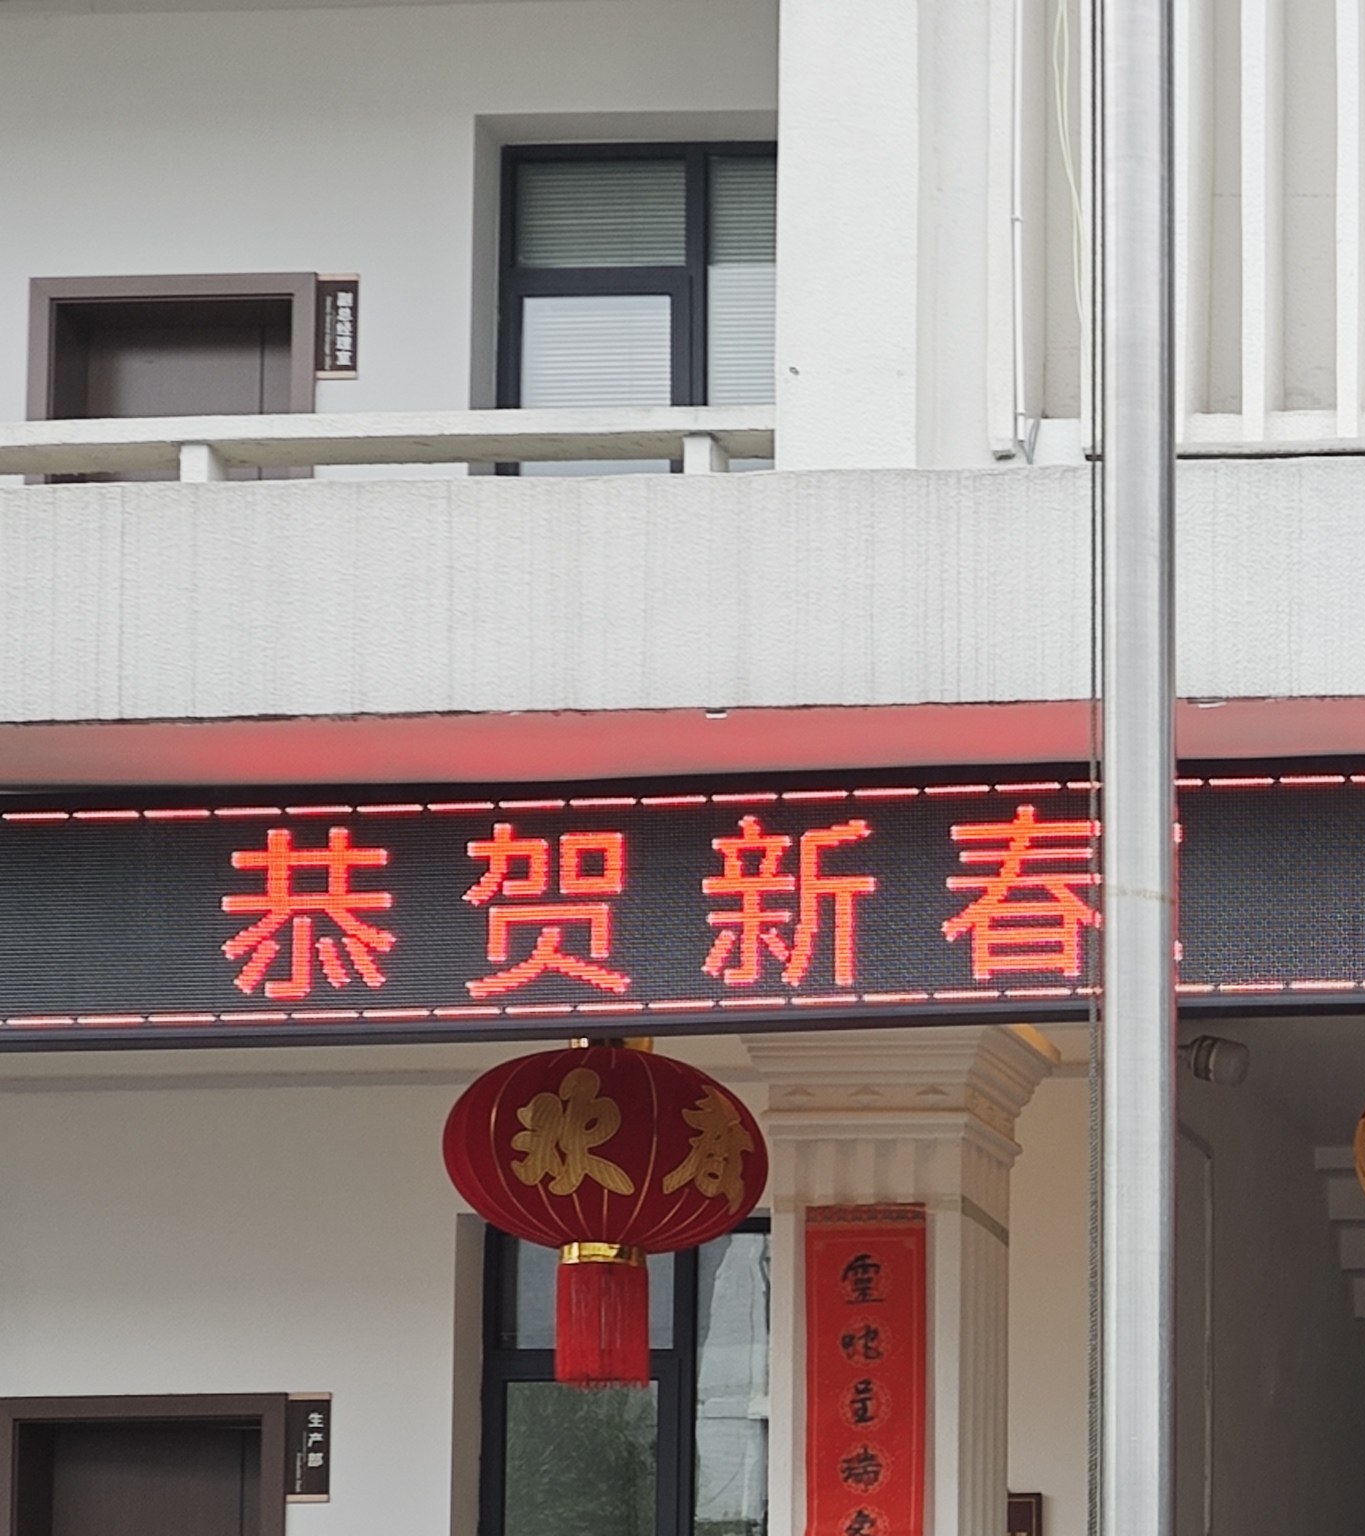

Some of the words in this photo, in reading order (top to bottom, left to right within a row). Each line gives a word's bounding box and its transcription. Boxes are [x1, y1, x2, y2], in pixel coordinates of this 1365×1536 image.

[222, 803, 1184, 999] 恭贺新春
[308, 1411, 324, 1467] 生产部
